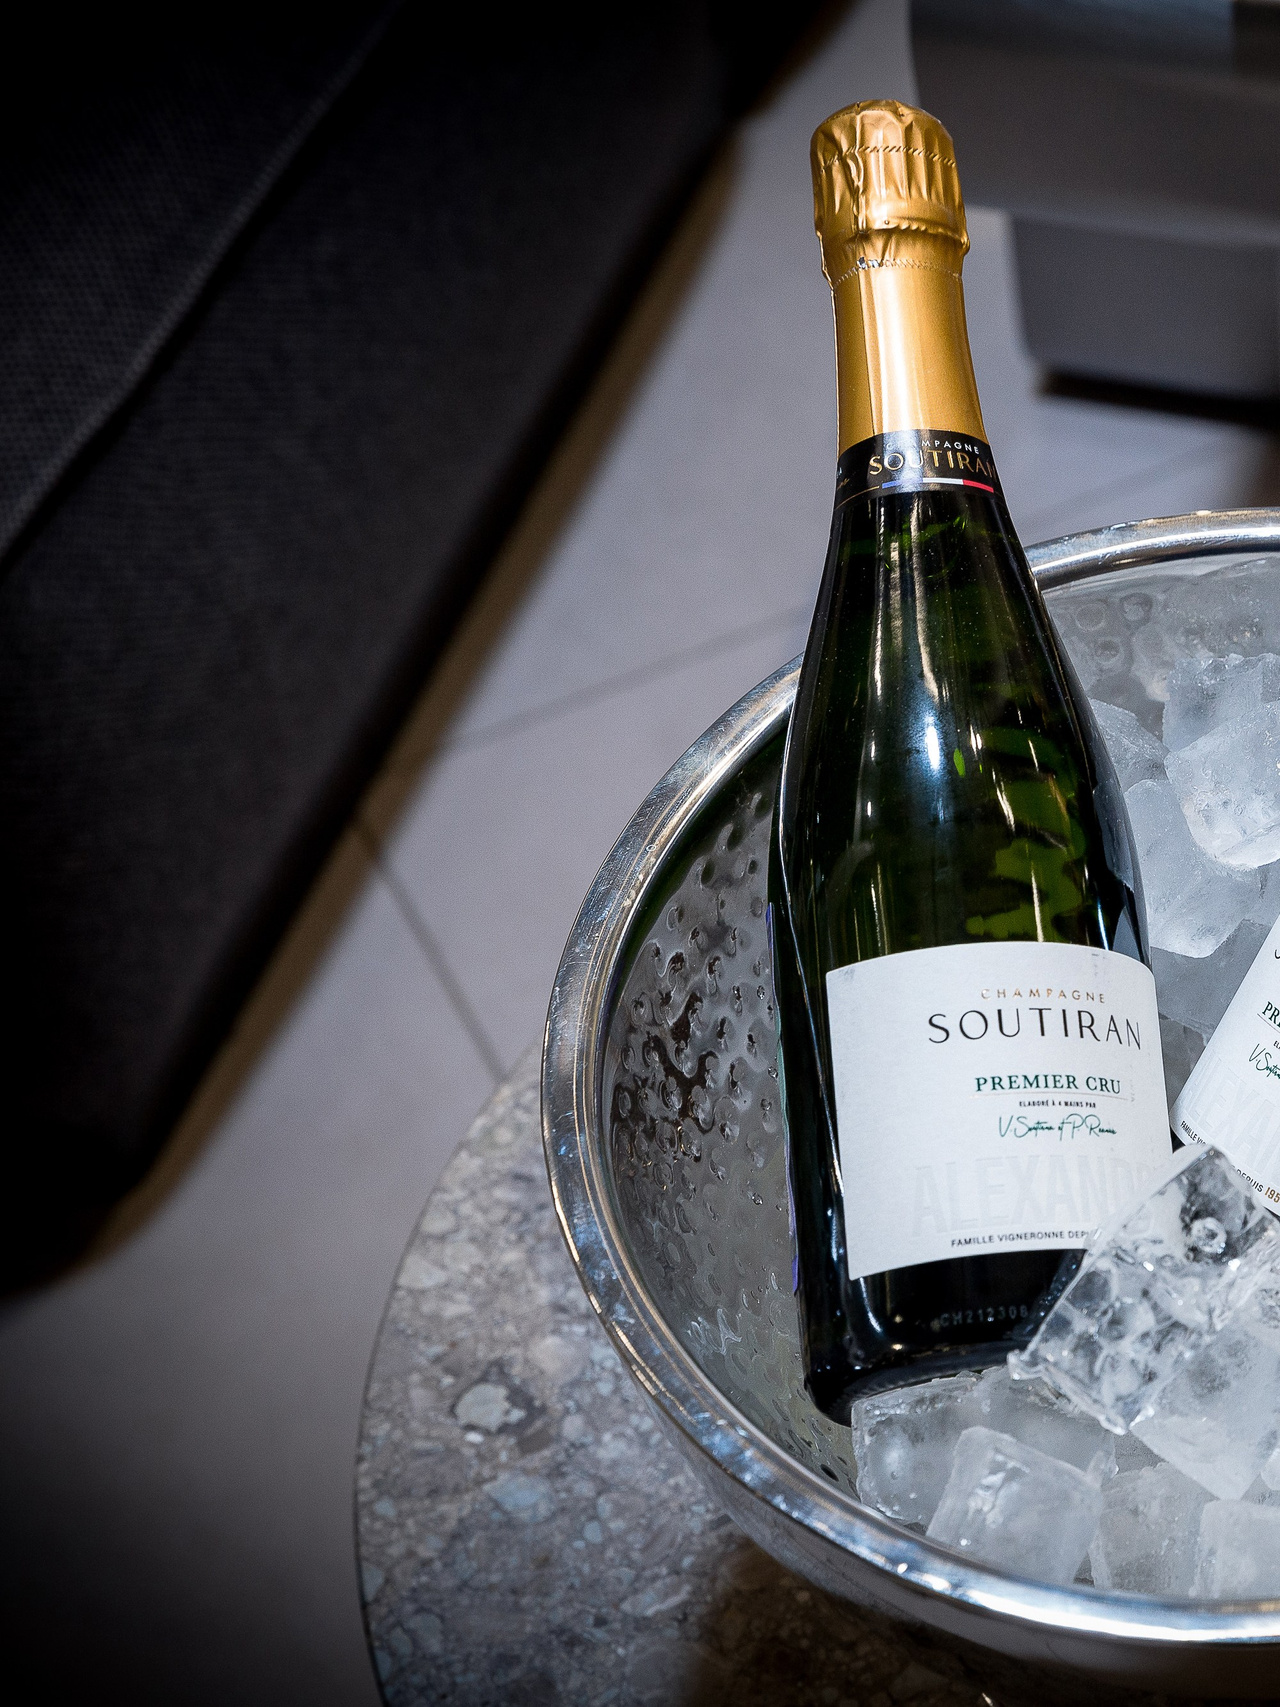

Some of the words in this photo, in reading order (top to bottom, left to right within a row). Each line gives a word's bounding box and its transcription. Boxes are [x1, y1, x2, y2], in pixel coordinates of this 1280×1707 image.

[981, 988, 1106, 1004] CHAMPAGNE
[928, 1008, 1141, 1050] SOUTIRAN
[975, 1074, 1079, 1092] PREMIER
[1086, 1076, 1121, 1094] CRU
[1180, 1120, 1198, 1142] FAMILLE
[951, 1235, 995, 1248] FAMILLE
[997, 1230, 1065, 1243] VIGNERONNE
